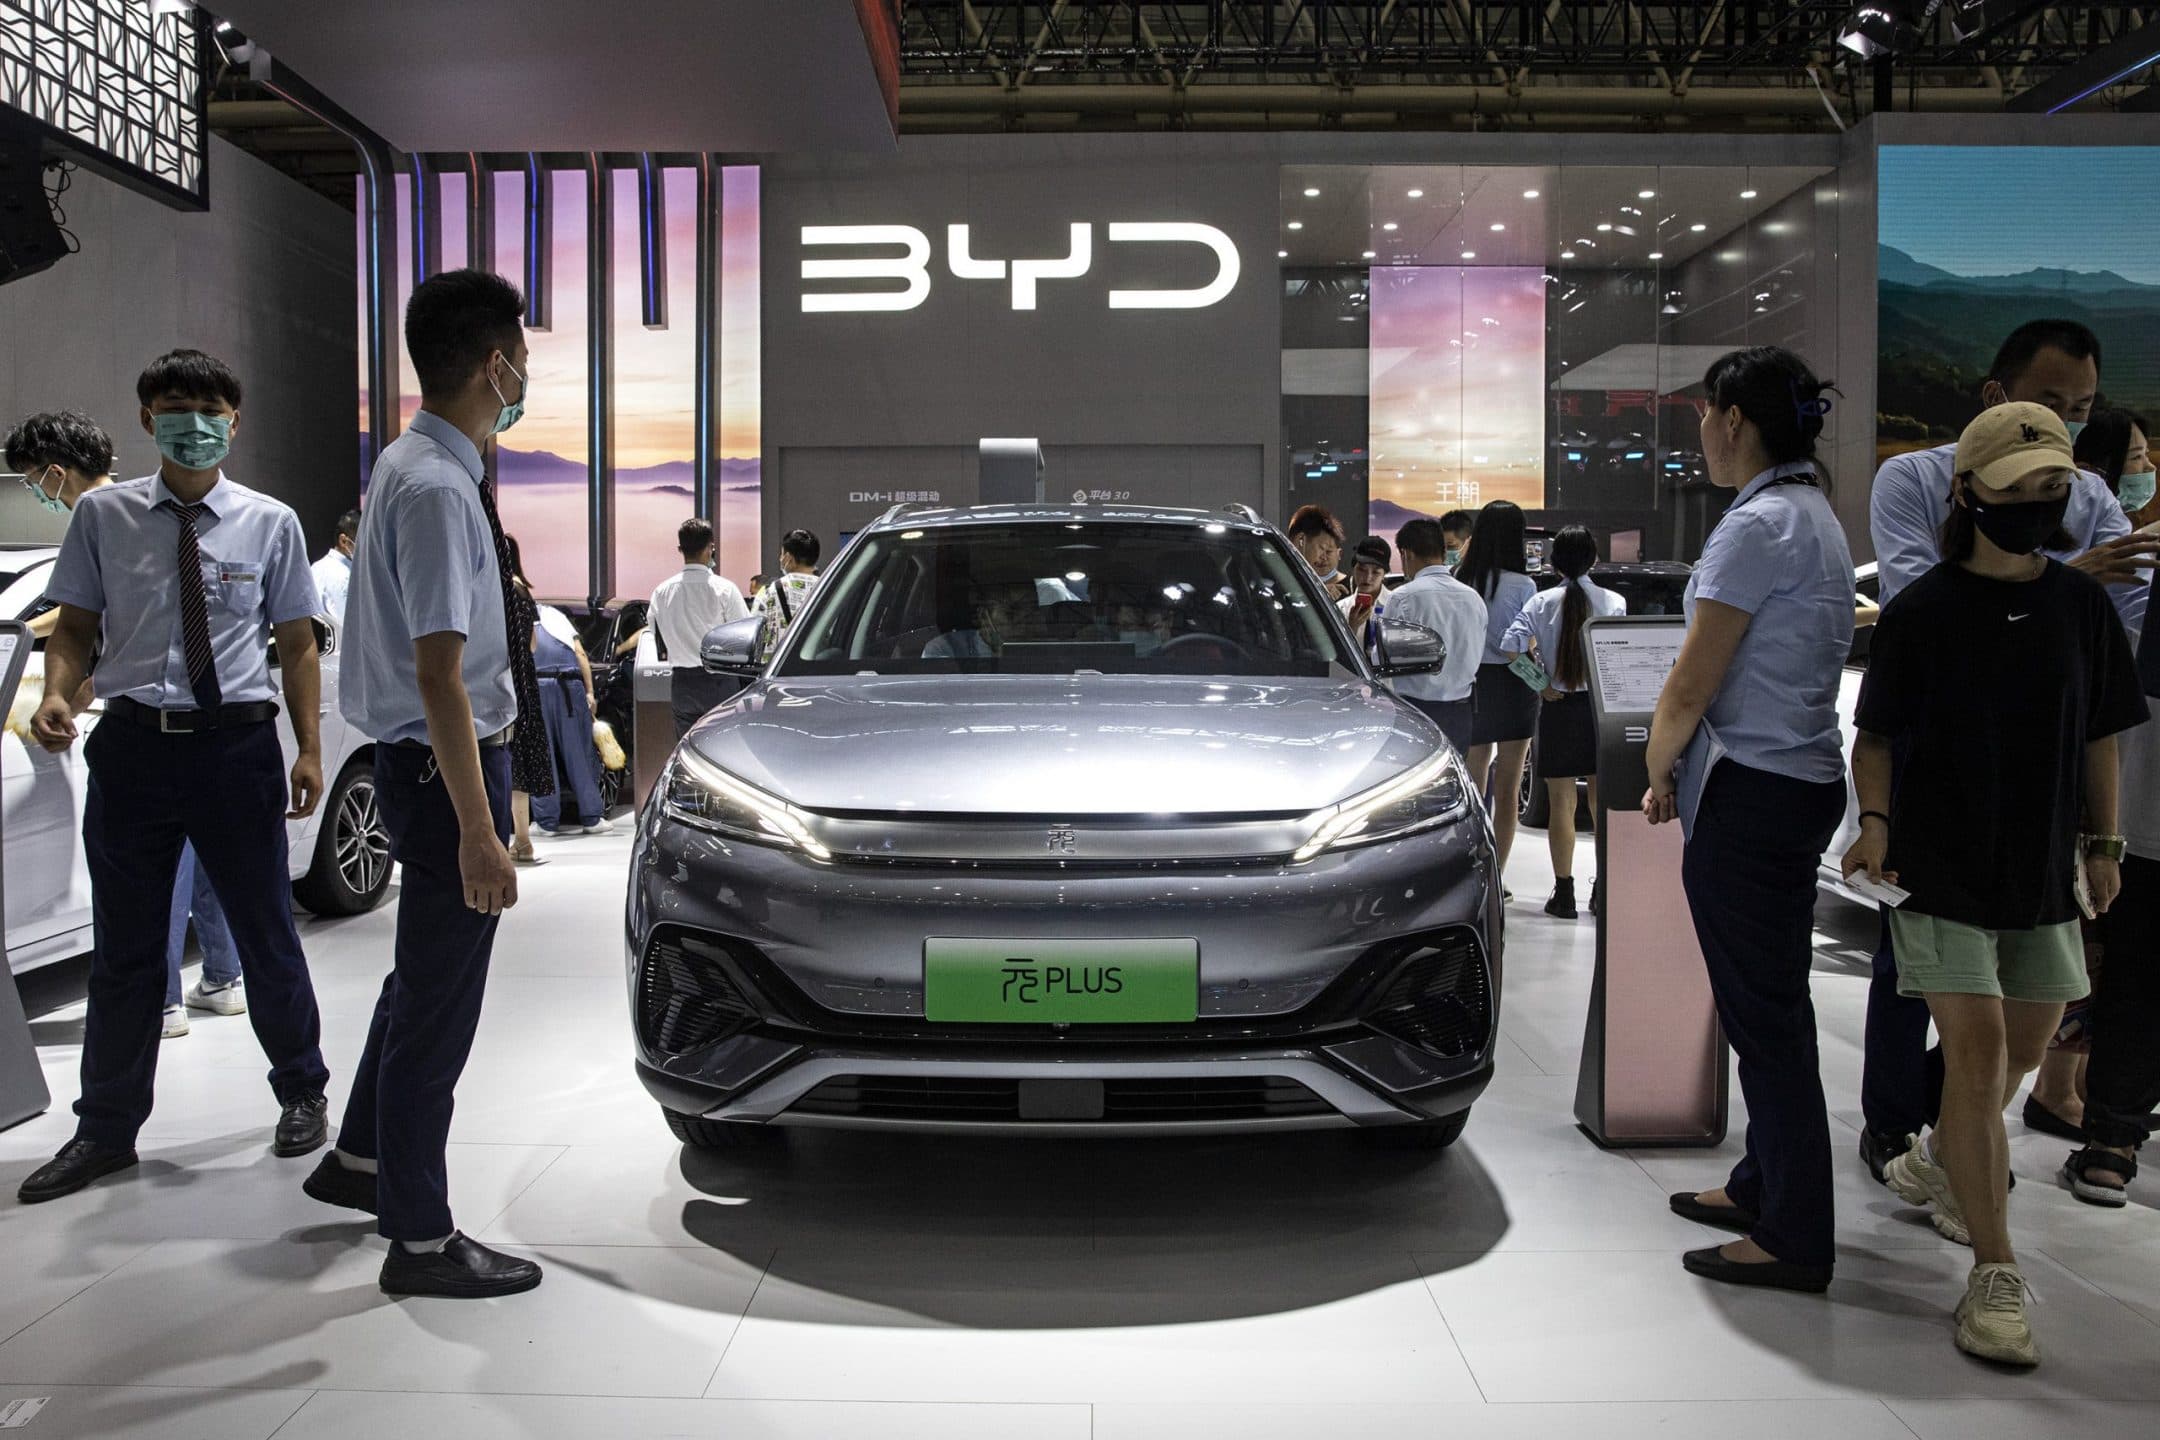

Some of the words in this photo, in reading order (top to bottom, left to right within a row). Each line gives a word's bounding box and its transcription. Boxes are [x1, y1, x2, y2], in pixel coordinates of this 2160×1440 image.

[801, 222, 1240, 312] BYD
[1433, 481, 1480, 507] 王朝
[1046, 967, 1123, 994] PLUS
